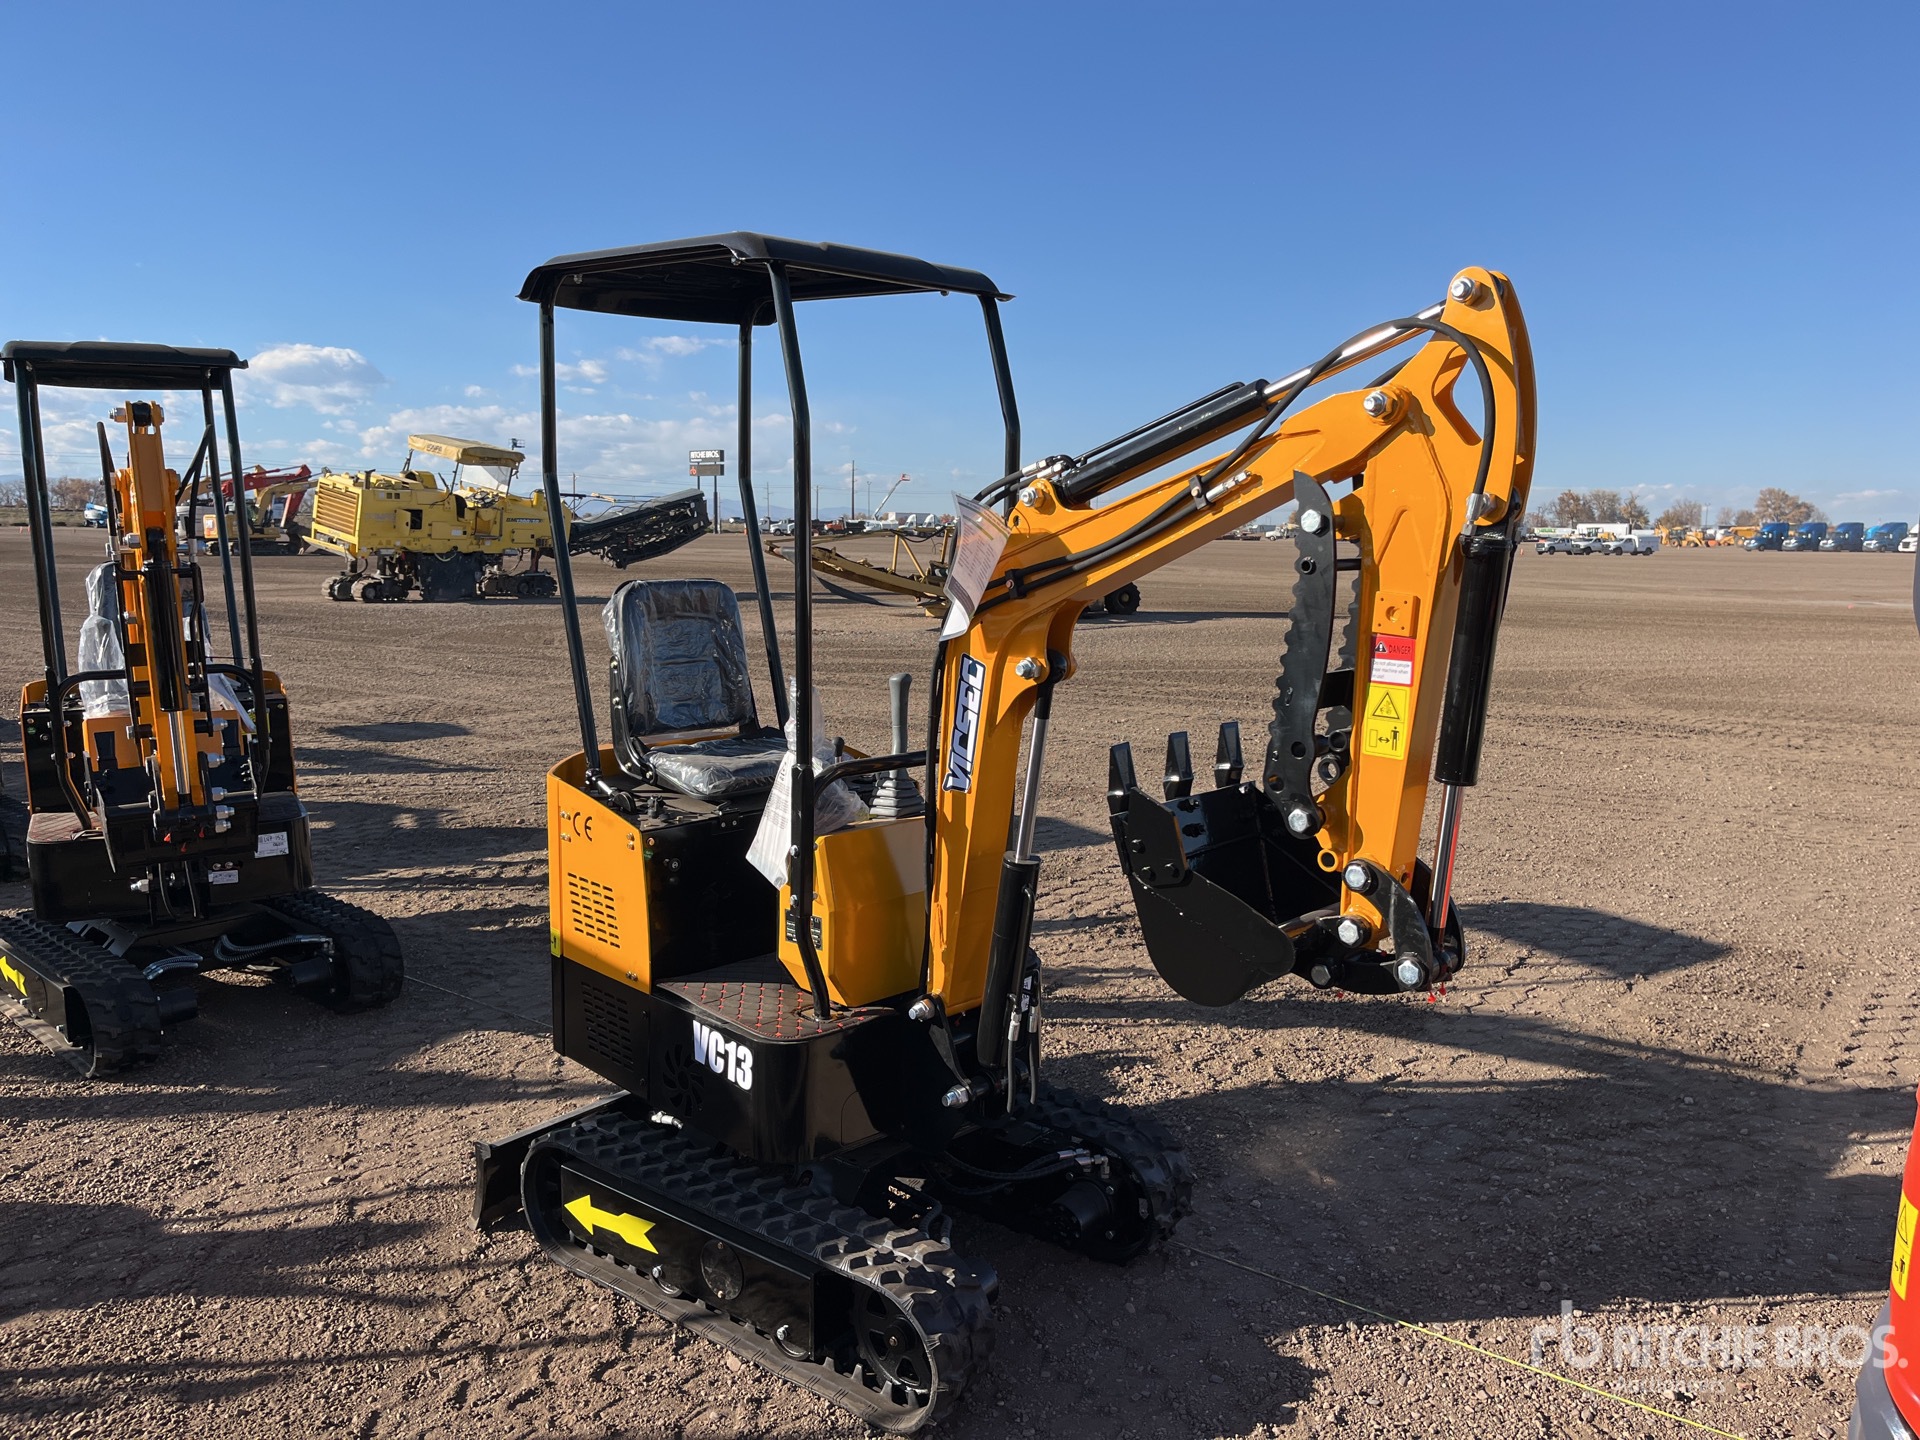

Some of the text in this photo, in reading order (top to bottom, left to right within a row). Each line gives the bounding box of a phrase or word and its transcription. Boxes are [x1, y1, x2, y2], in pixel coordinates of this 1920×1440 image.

[1389, 644, 1411, 655] DANGER
[944, 653, 985, 792] VICSEC
[572, 811, 593, 842] CE
[692, 1019, 754, 1091] VC13
